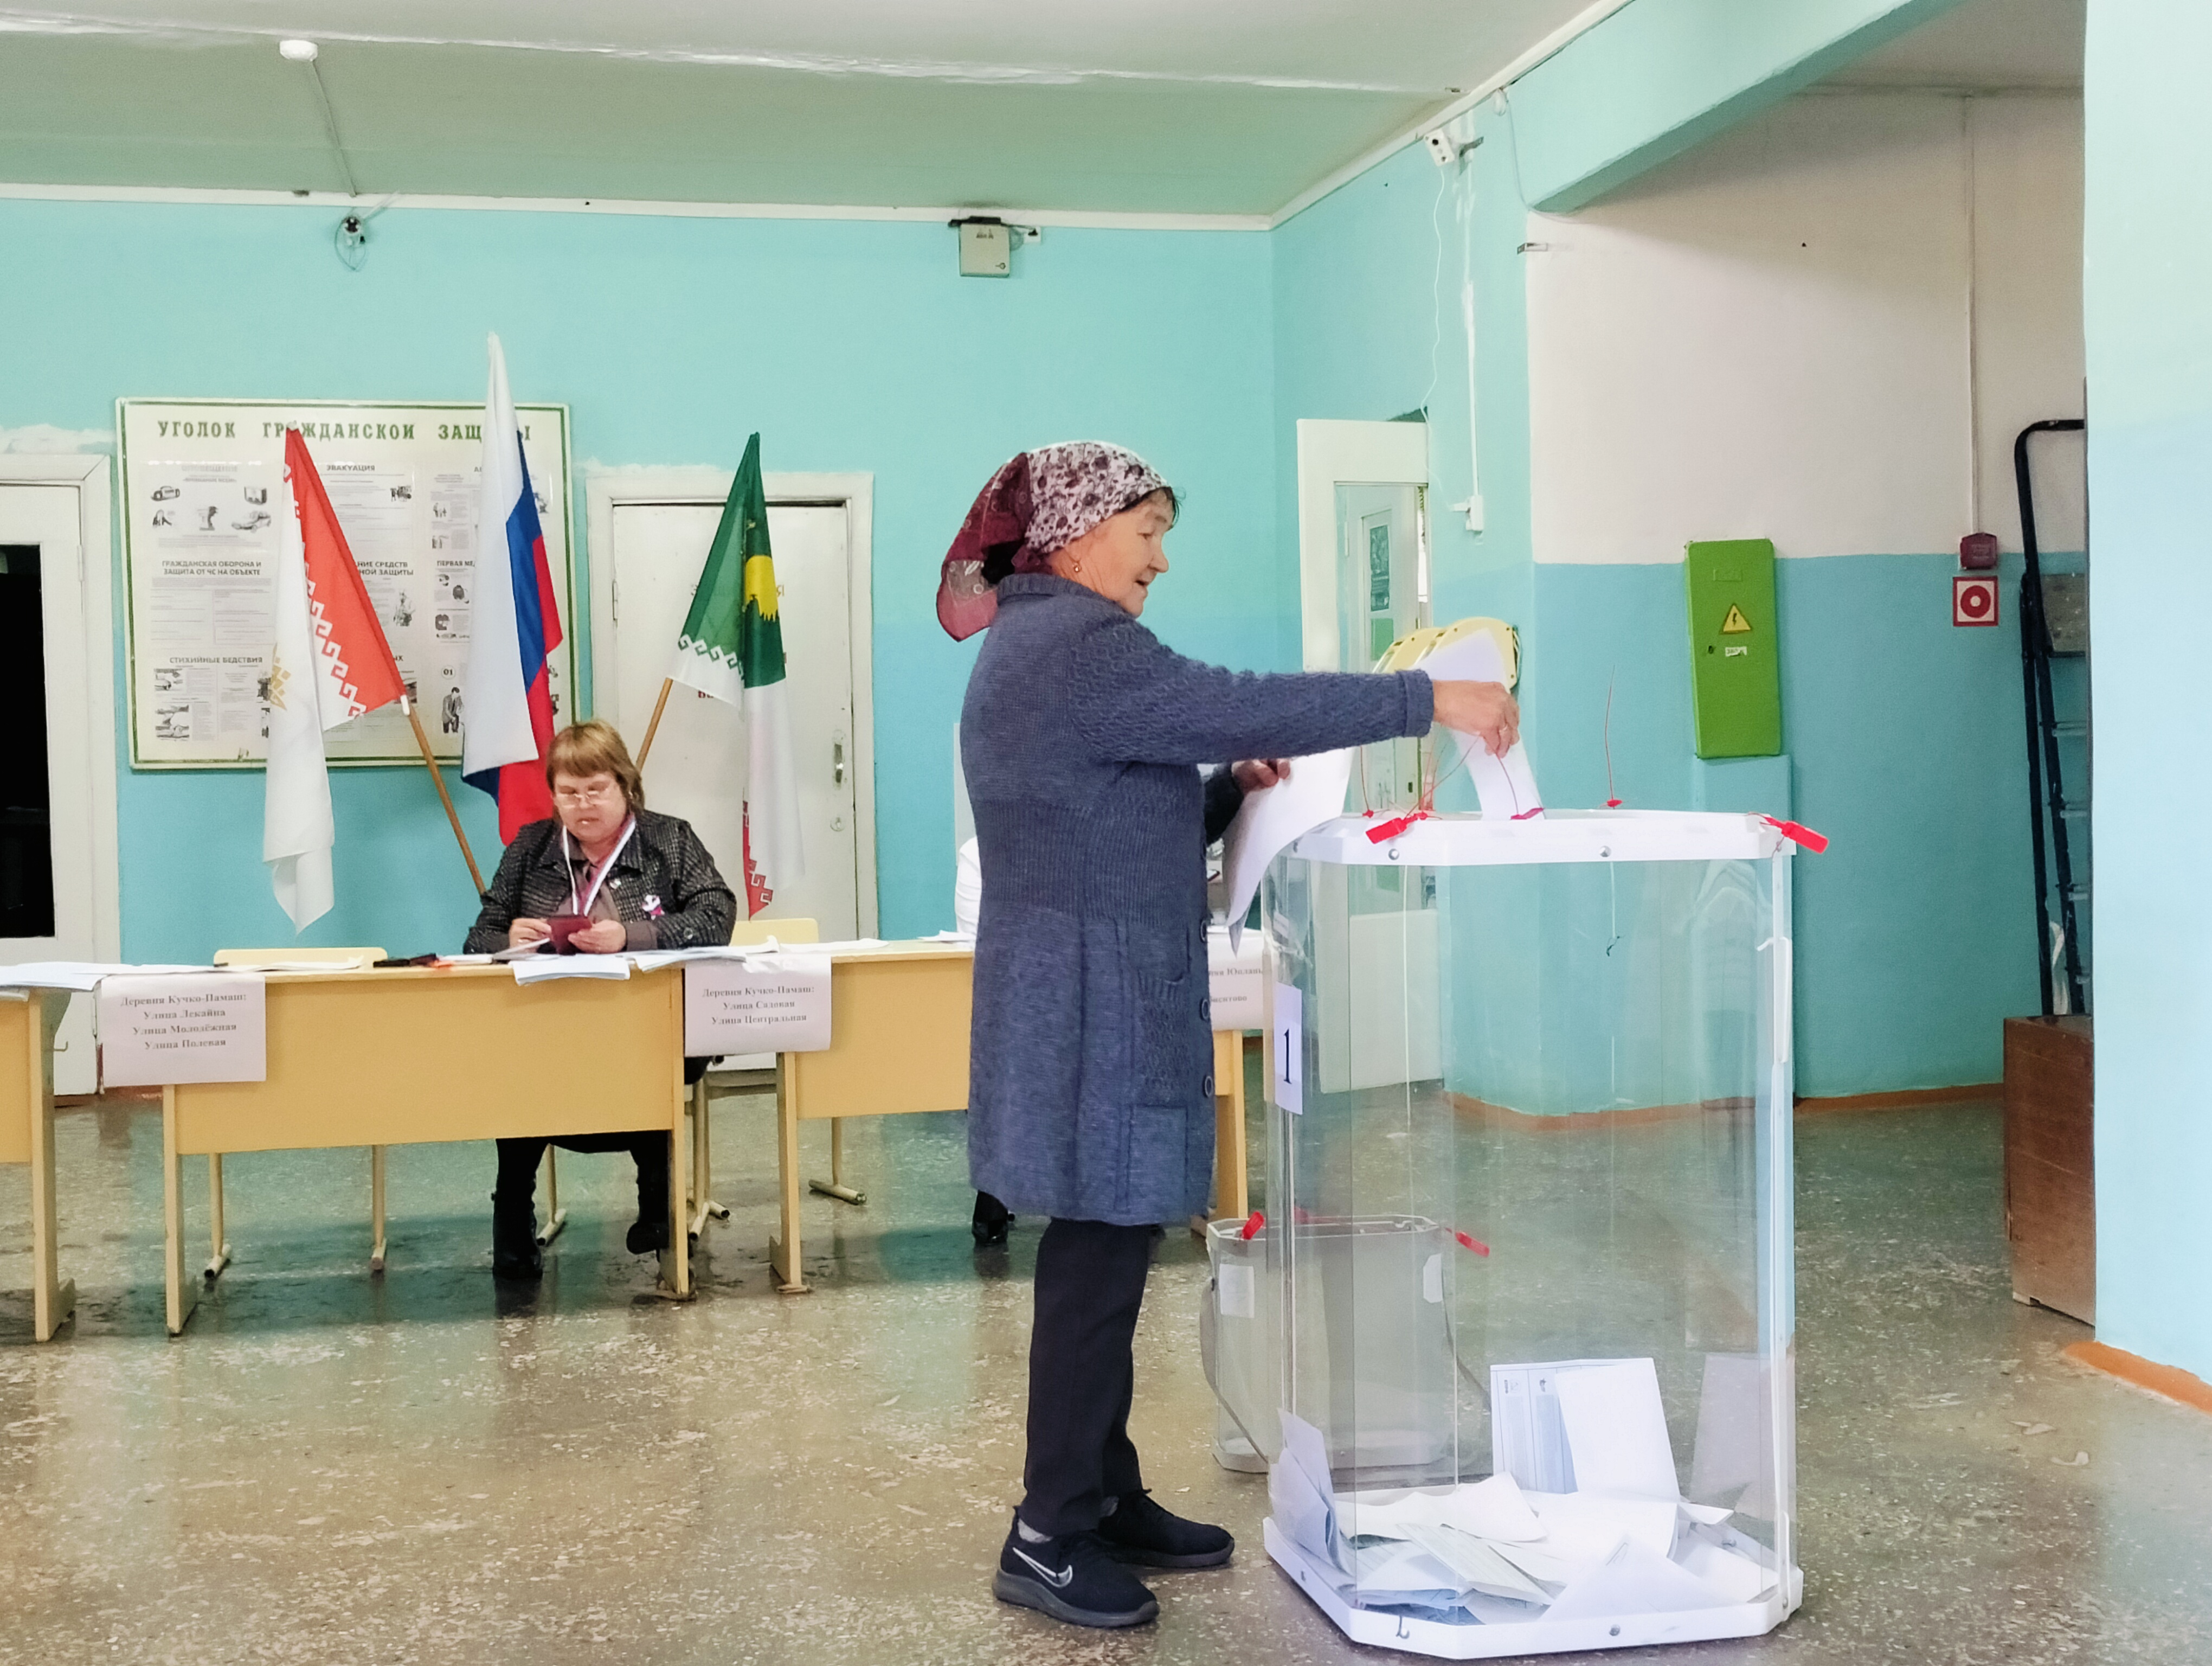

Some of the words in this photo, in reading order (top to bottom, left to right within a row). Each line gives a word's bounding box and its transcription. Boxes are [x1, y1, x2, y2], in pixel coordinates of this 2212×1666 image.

[158, 420, 235, 439] УГОЛОК
[702, 988, 742, 998] Деревня
[120, 997, 164, 1007] Деревня
[723, 1002, 753, 1010] Улица
[756, 1001, 795, 1009] Садовая
[143, 1011, 177, 1020] Улица
[712, 1016, 742, 1024] Улица
[745, 1014, 807, 1024] Центральная
[133, 1027, 167, 1035] Улица
[170, 1023, 237, 1034] Молодёжная
[145, 1041, 178, 1050] Улица
[182, 1040, 226, 1048] Полевая
